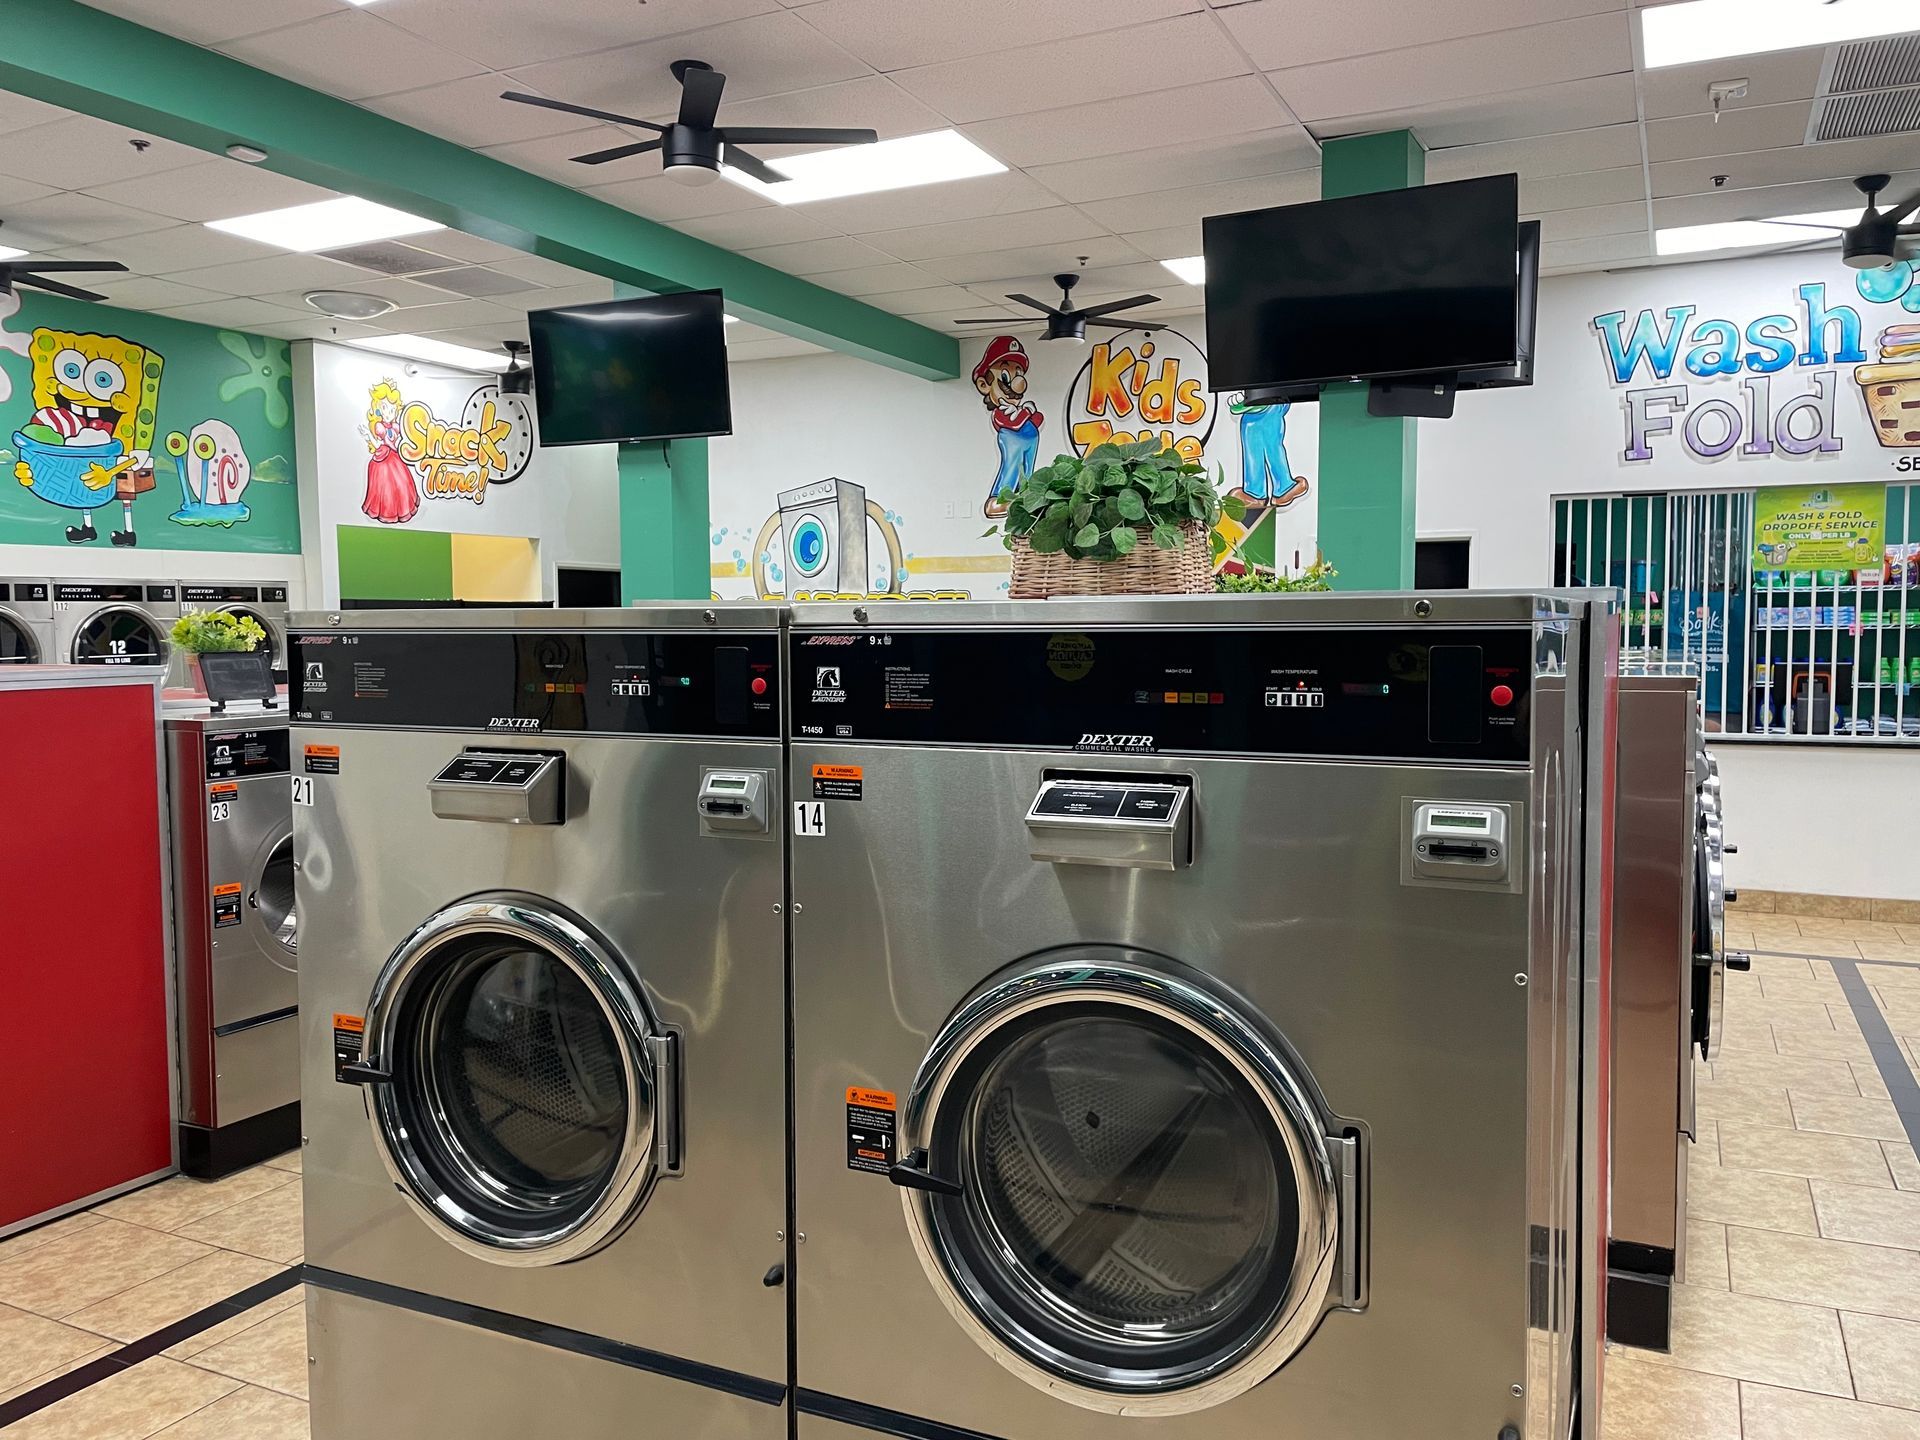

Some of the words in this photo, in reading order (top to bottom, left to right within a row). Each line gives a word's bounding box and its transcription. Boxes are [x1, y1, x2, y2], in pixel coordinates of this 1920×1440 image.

[1593, 282, 1867, 383] Wash
[1086, 342, 1207, 424] Kids
[1624, 371, 1843, 461] Fold
[400, 401, 512, 472] Snack
[420, 457, 489, 501] Time!
[1776, 512, 1814, 521] WASH
[1817, 511, 1825, 519] &
[1829, 511, 1862, 519] FOLD
[1825, 520, 1878, 530] SERVICE
[109, 640, 127, 654] 12
[806, 635, 857, 645] EXPRESS
[869, 636, 876, 645] 9
[488, 717, 539, 728] DEXTER
[801, 726, 823, 734] T-1450
[1075, 744, 1122, 752] COMMERCIAL
[1077, 733, 1154, 747] DEXTER
[293, 777, 311, 805] 21
[212, 803, 229, 821] 23
[798, 803, 823, 833] 14
